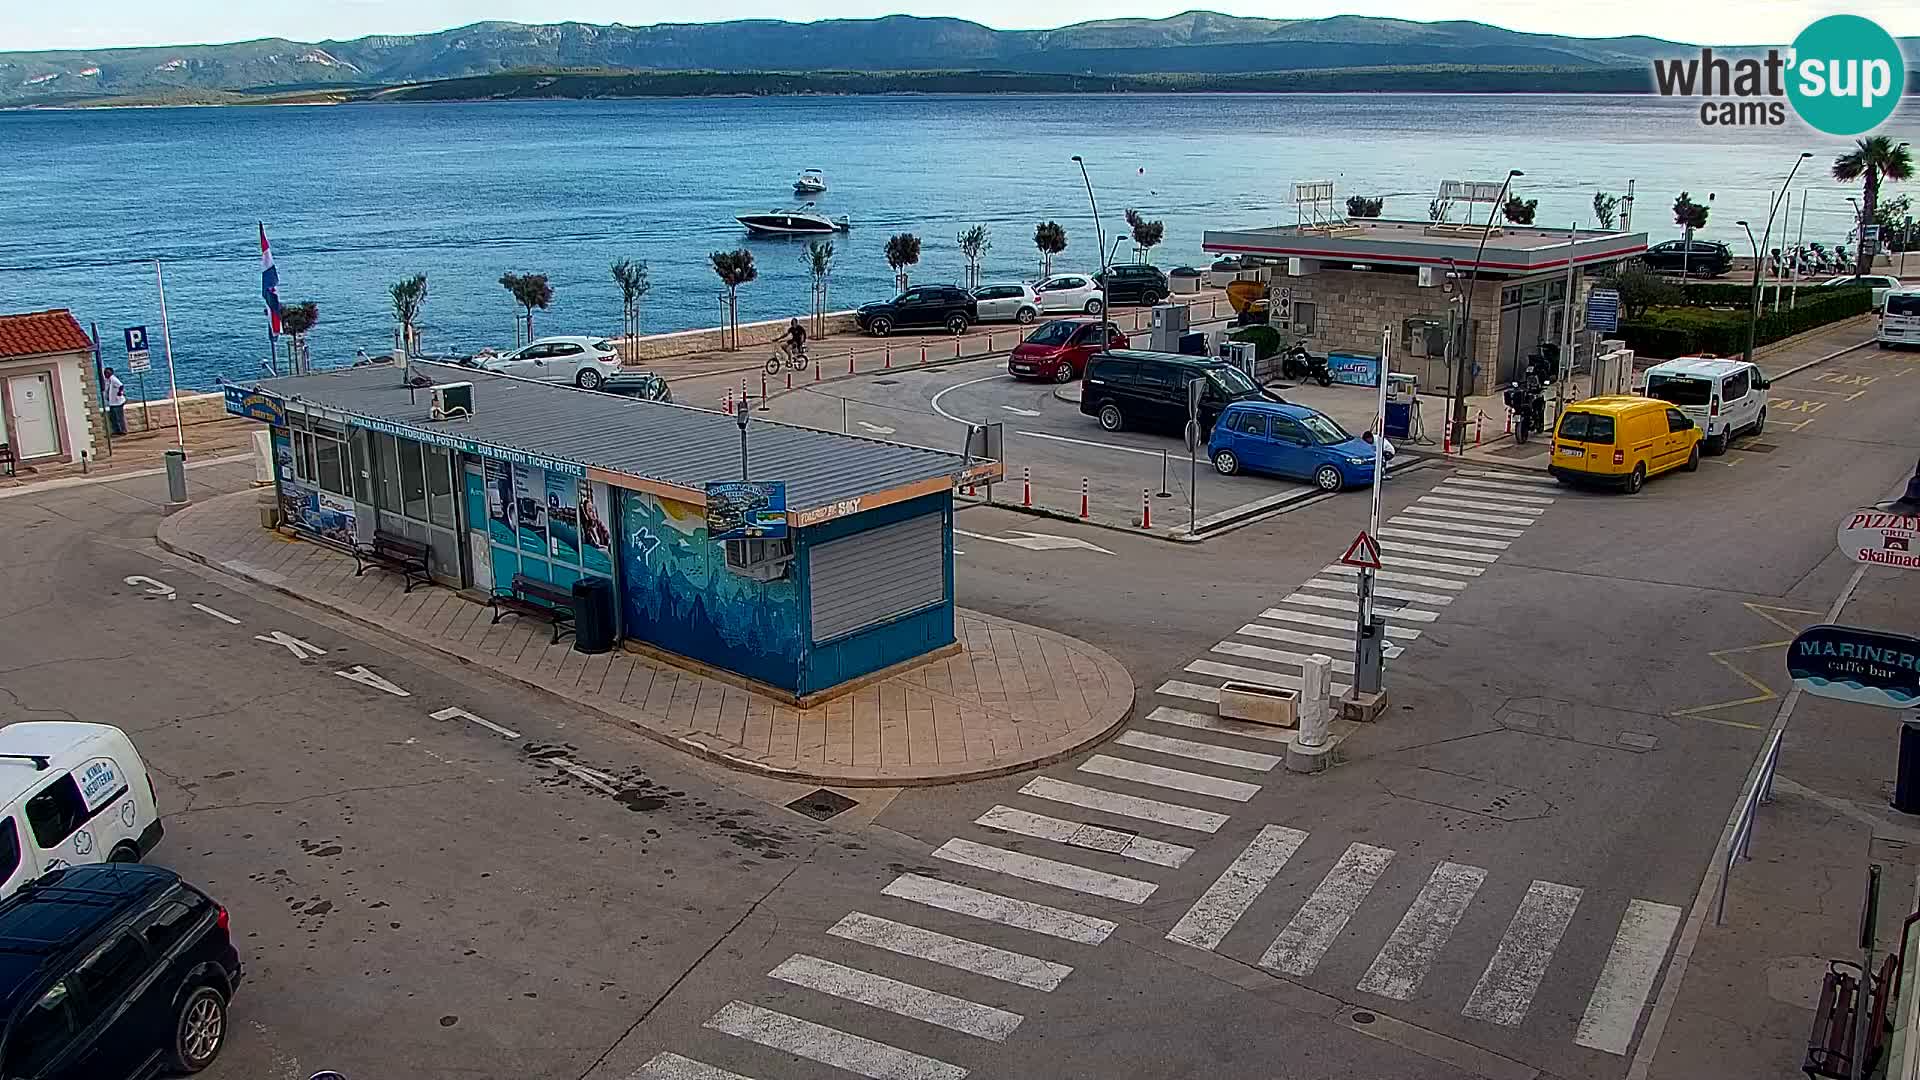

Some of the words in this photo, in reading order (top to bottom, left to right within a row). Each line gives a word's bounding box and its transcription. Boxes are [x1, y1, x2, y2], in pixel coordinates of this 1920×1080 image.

[130, 330, 142, 348] P
[395, 425, 435, 443] AUTOBUSNA
[436, 436, 468, 450] POSTAJA
[477, 444, 493, 456] BUS
[493, 448, 526, 464] STATION
[527, 455, 554, 470] TICKET
[555, 462, 583, 476] OFFICE
[1847, 513, 1920, 532] PIZZE
[1880, 529, 1917, 539] GRILL
[1828, 660, 1865, 673] caffe
[1870, 664, 1896, 678] bar
